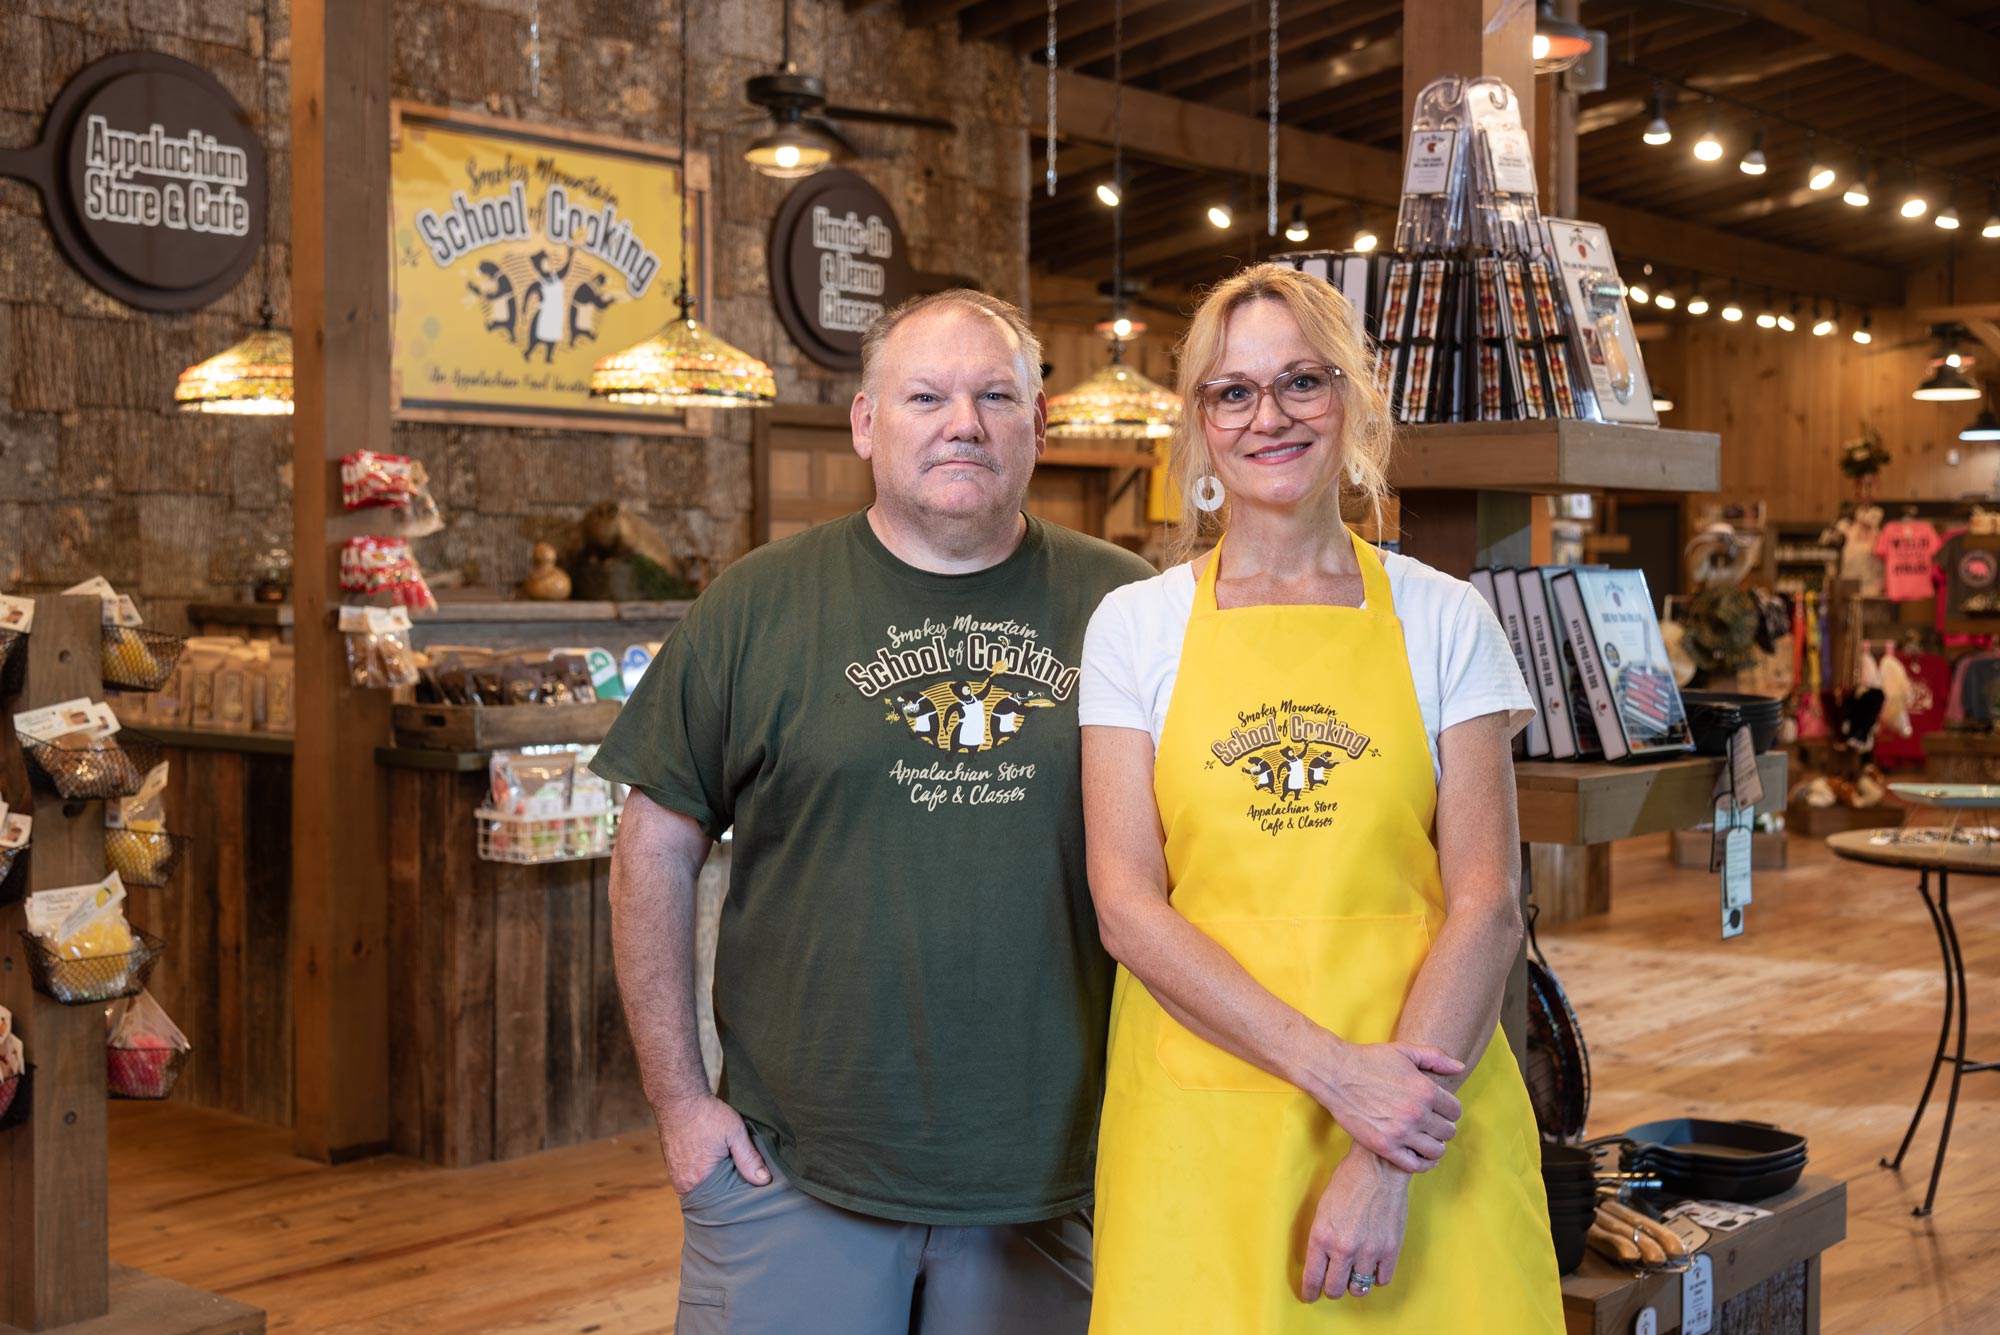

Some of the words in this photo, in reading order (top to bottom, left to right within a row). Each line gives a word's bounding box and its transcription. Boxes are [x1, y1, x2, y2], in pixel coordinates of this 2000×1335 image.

[86, 115, 248, 186] Appalachian
[85, 167, 160, 227] Store
[189, 181, 249, 236] Cafe
[466, 153, 530, 195] Smoky
[534, 156, 619, 207] Mountain
[417, 180, 531, 267] School
[529, 198, 546, 232] of
[547, 183, 661, 298] Cooking
[887, 617, 951, 649] Smoky
[952, 614, 1039, 640] Mountain
[845, 635, 951, 697] School
[948, 644, 966, 666] of
[967, 633, 1080, 701] Cooking
[1238, 703, 1277, 727] Smoky
[1279, 699, 1338, 717] Mountain
[1210, 716, 1282, 767] School
[1277, 719, 1289, 738] of
[1289, 713, 1371, 760] Cooking
[888, 759, 993, 786] Appalachian
[996, 762, 1036, 781] Store
[910, 783, 948, 812] Cafe
[951, 786, 965, 804] &
[969, 783, 1027, 805] Classes
[1247, 801, 1311, 822] Appalachian
[1313, 800, 1338, 814] Store
[1260, 818, 1284, 837] Cafe
[1286, 818, 1295, 830] &
[1297, 815, 1334, 829] Classes
